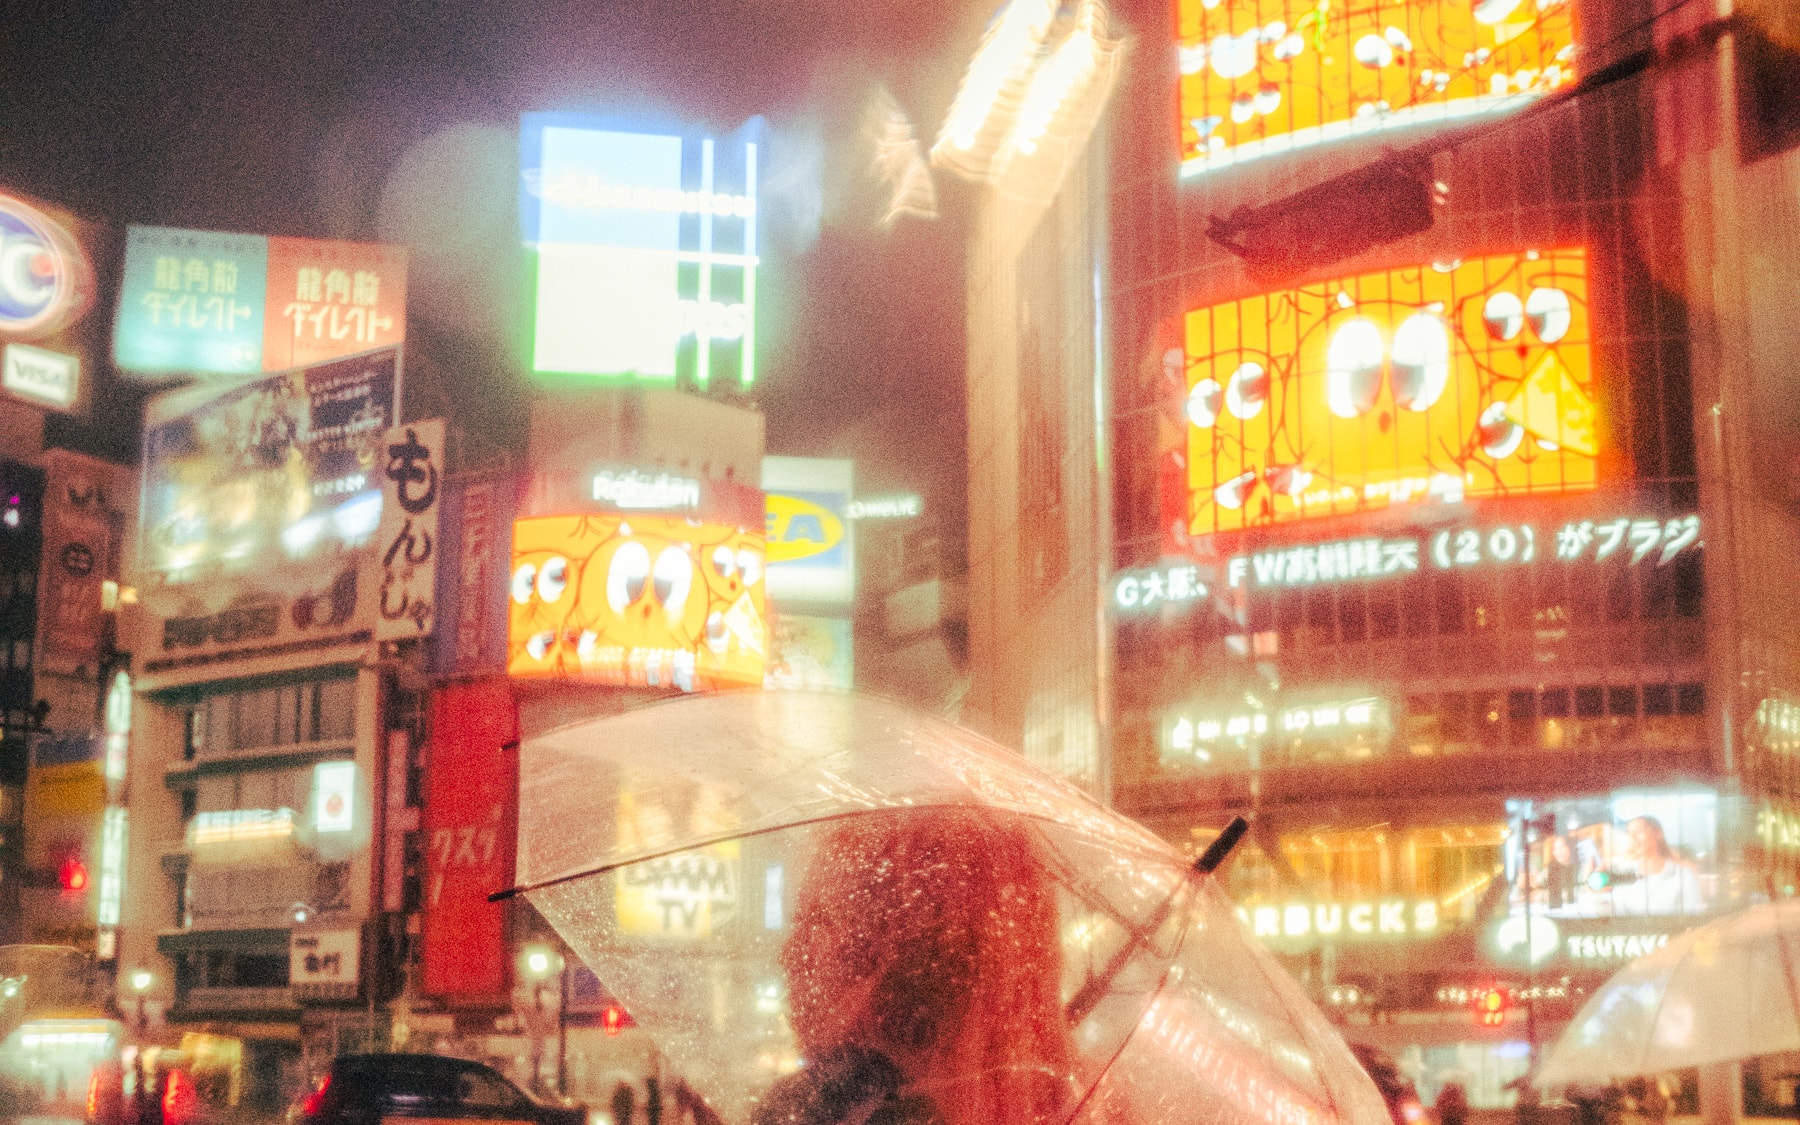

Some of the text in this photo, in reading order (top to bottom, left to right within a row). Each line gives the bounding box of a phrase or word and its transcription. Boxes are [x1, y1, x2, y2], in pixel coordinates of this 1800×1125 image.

[593, 471, 699, 507] Rakuten
[381, 427, 439, 632] もんじゃ
[1235, 901, 1438, 937] RBUCKS
